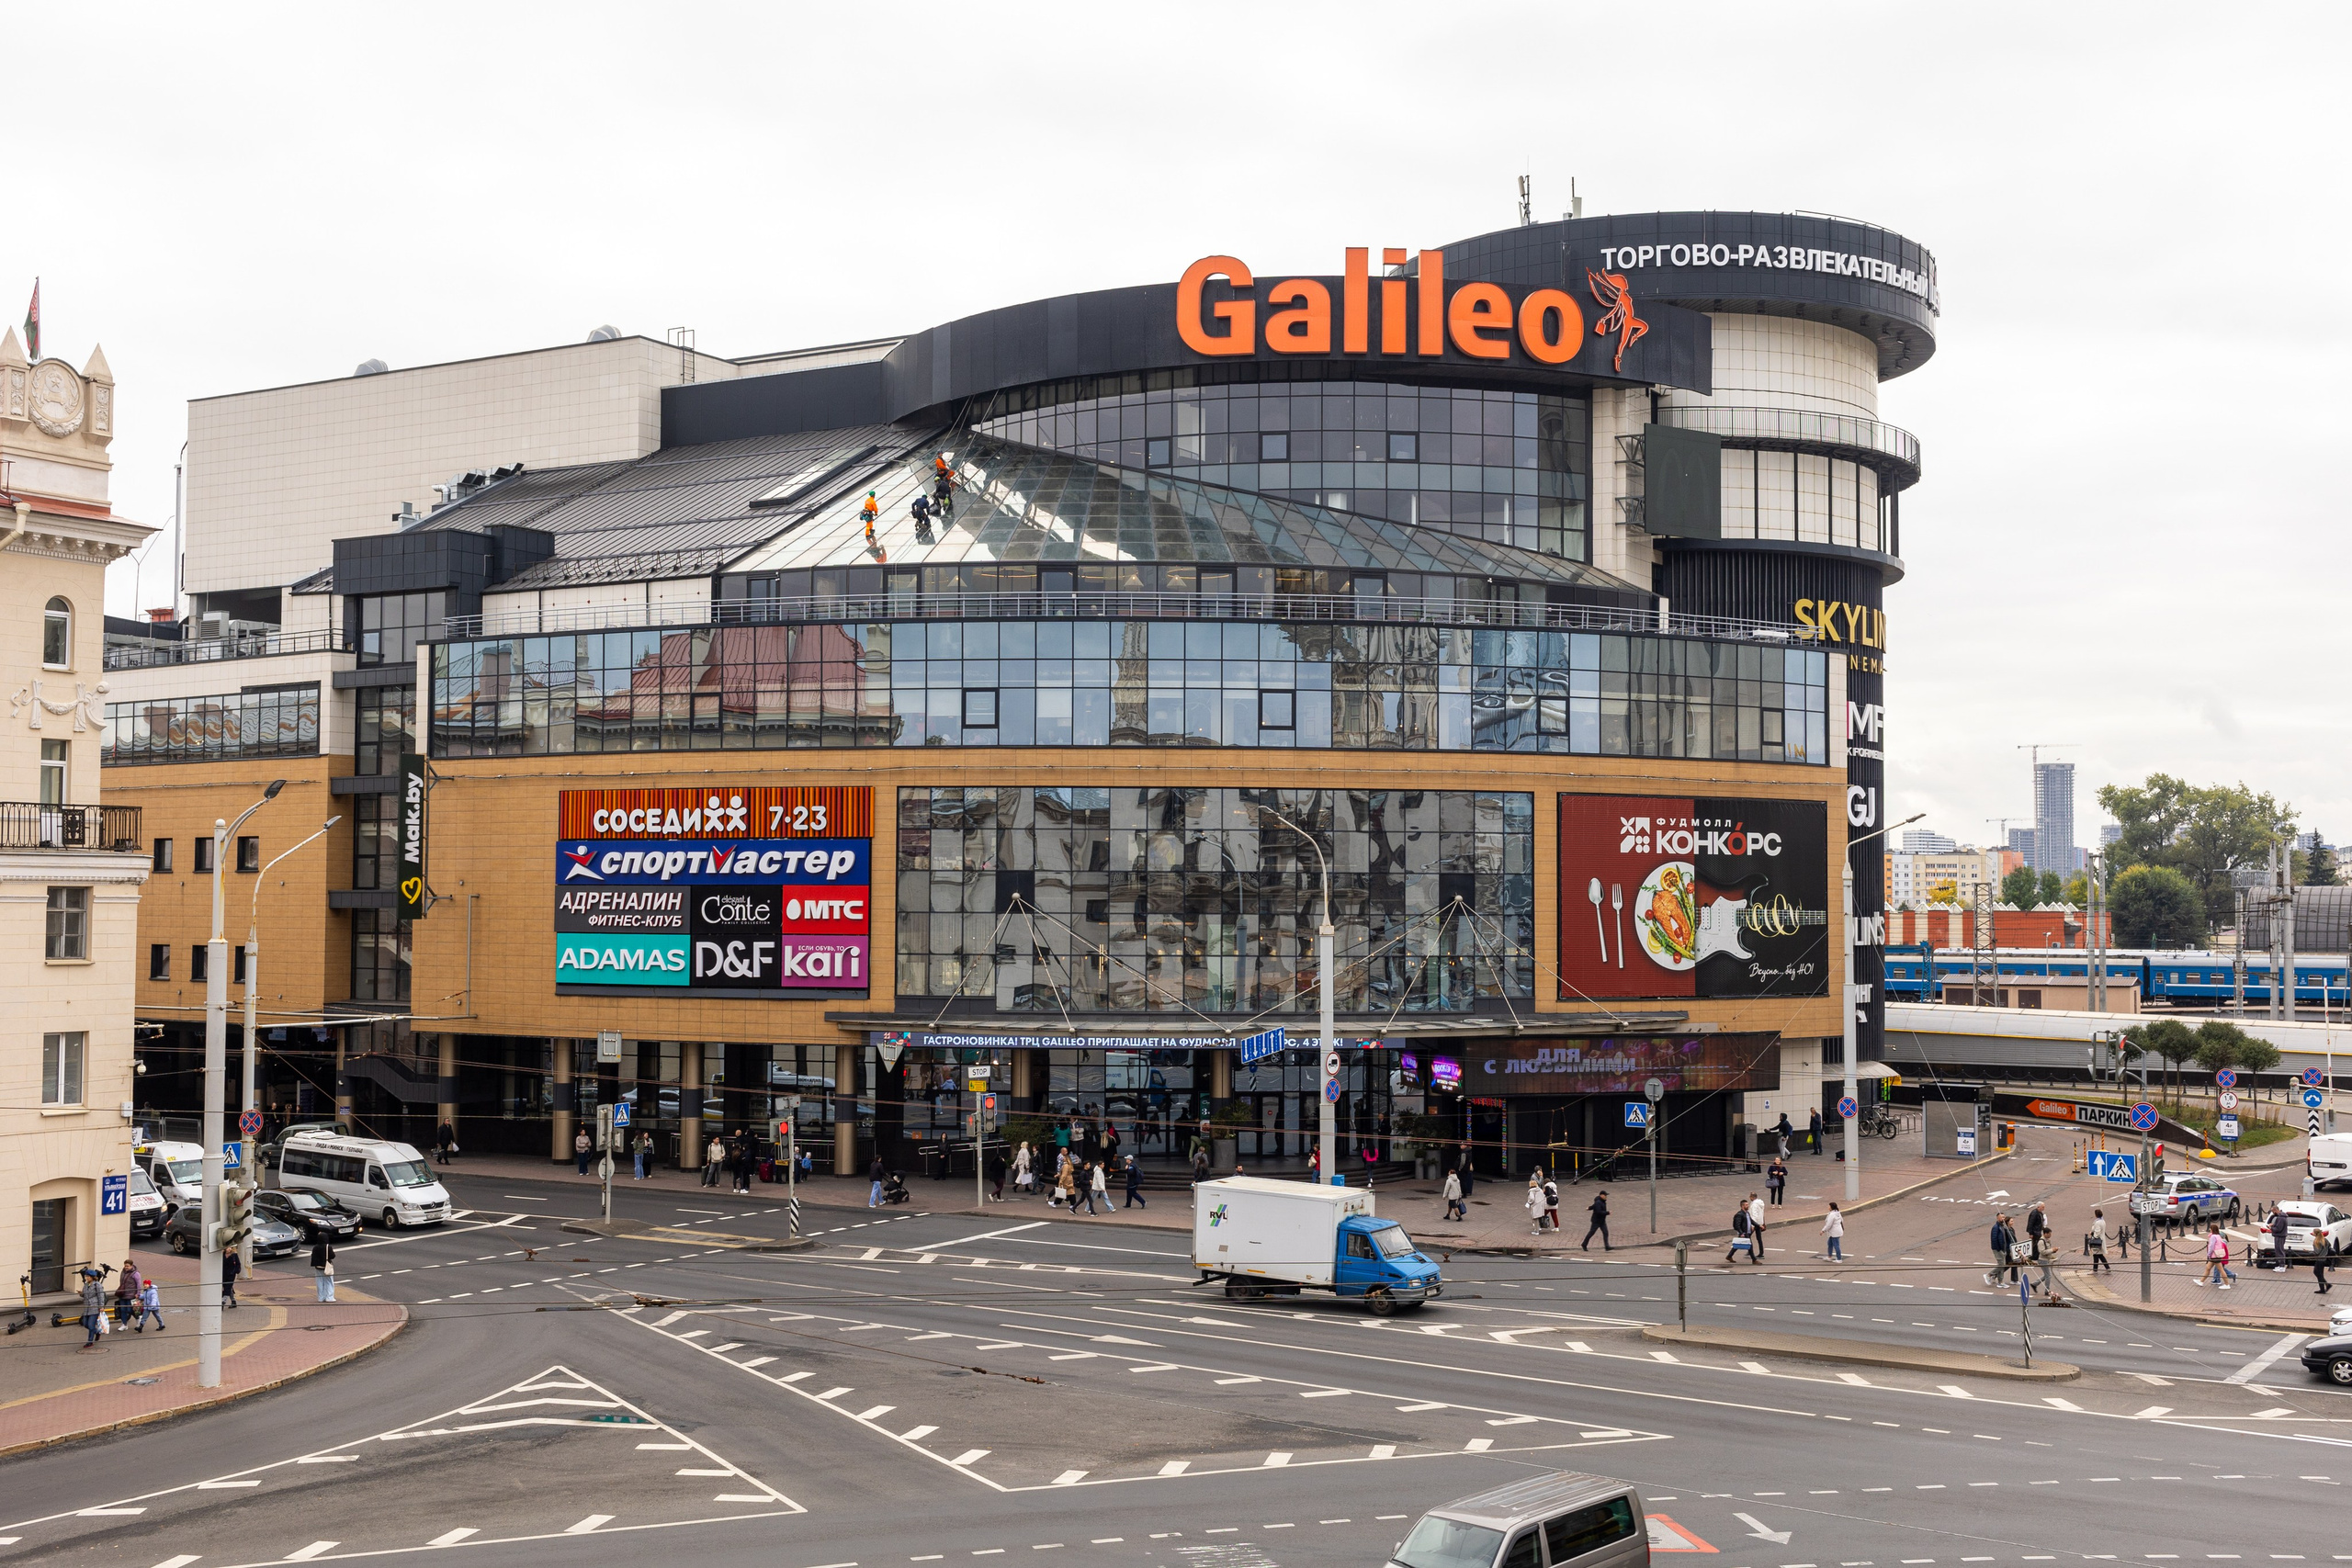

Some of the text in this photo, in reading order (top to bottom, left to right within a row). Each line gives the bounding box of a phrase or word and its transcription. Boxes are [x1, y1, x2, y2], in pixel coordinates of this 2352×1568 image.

[1600, 243, 1928, 299] ТОРГОВО-РАЗВЛЕКАТЕЛЬНЫЙ
[1175, 246, 1583, 365] Galileo
[404, 772, 424, 863] Mak.by
[1847, 785, 1875, 828] GJ
[1657, 818, 1732, 828] ФУДМОЛЛ
[560, 892, 683, 914] АДРЕНАЛИН
[701, 895, 770, 923] Conte
[588, 915, 683, 928] ФИТНЕС-КЛУБ
[1852, 911, 1885, 946] LIN'S
[559, 947, 686, 972] ADAMAS
[695, 941, 775, 978] D&F
[785, 945, 861, 977] kari
[923, 1035, 1018, 1046] ГАСТРОНОВИНКА!
[1020, 1037, 1040, 1047] ТРЦ
[1042, 1037, 1086, 1046] GALILEO
[1088, 1037, 1159, 1047] ПРИГЛАШАЕТ
[1161, 1038, 1177, 1046] НА
[1302, 1038, 1310, 1047] 4
[972, 1068, 988, 1077] STOP
[2039, 1101, 2067, 1115] Galileo
[2078, 1106, 2135, 1129] ПАРКИН
[106, 1191, 123, 1211] 41
[2143, 1201, 2159, 1213] STOP
[1209, 1211, 1227, 1220] RVL
[2014, 1243, 2030, 1258] STOP
